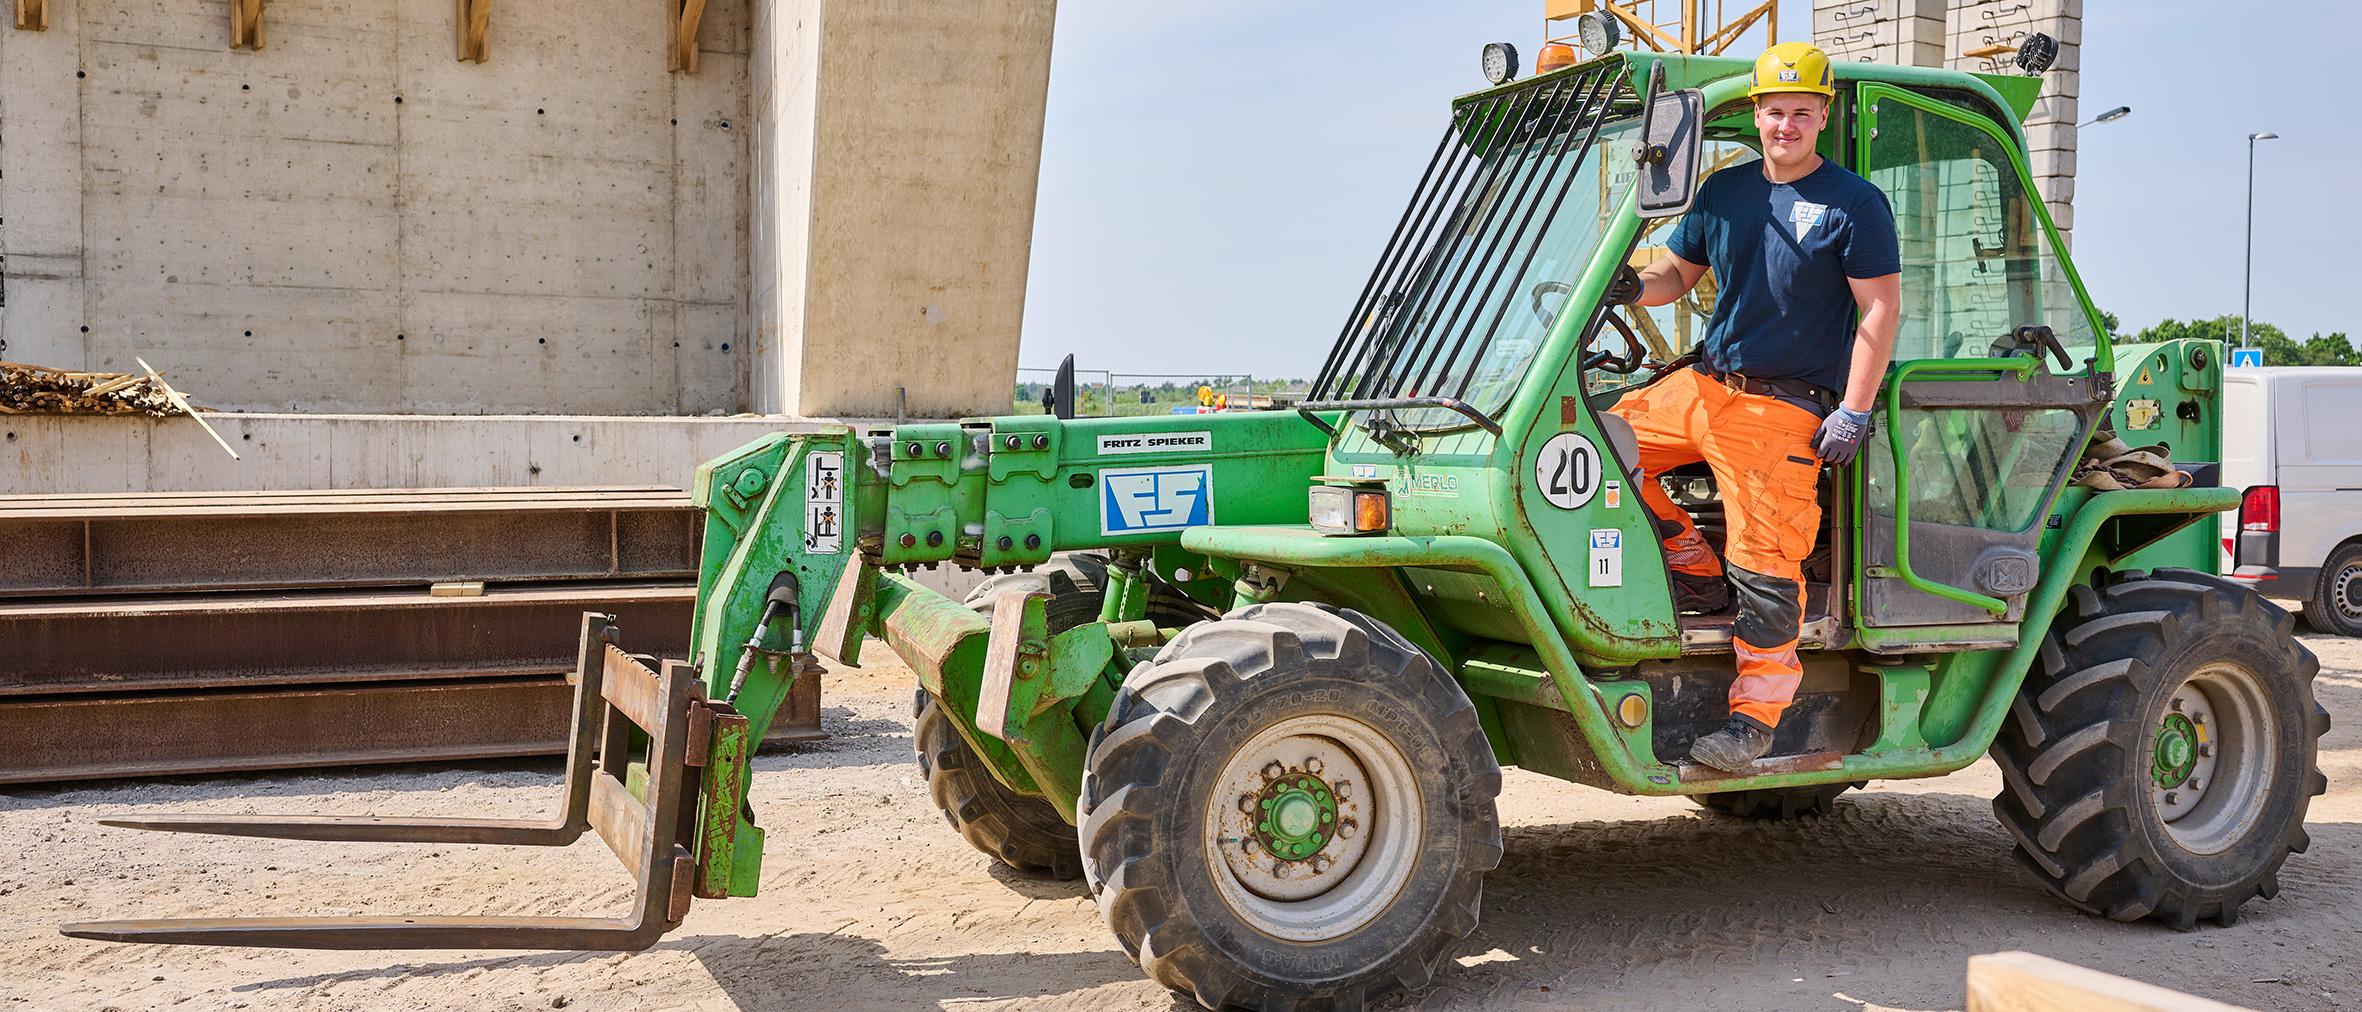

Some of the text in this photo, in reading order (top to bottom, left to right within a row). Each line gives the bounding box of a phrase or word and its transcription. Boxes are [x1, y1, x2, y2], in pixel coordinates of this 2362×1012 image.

[1103, 437, 1205, 448] FRITZ SPIEKER
[1549, 446, 1590, 495] 20
[1411, 474, 1458, 491] MERLO
[1106, 471, 1205, 529] FS
[1598, 557, 1609, 575] 11
